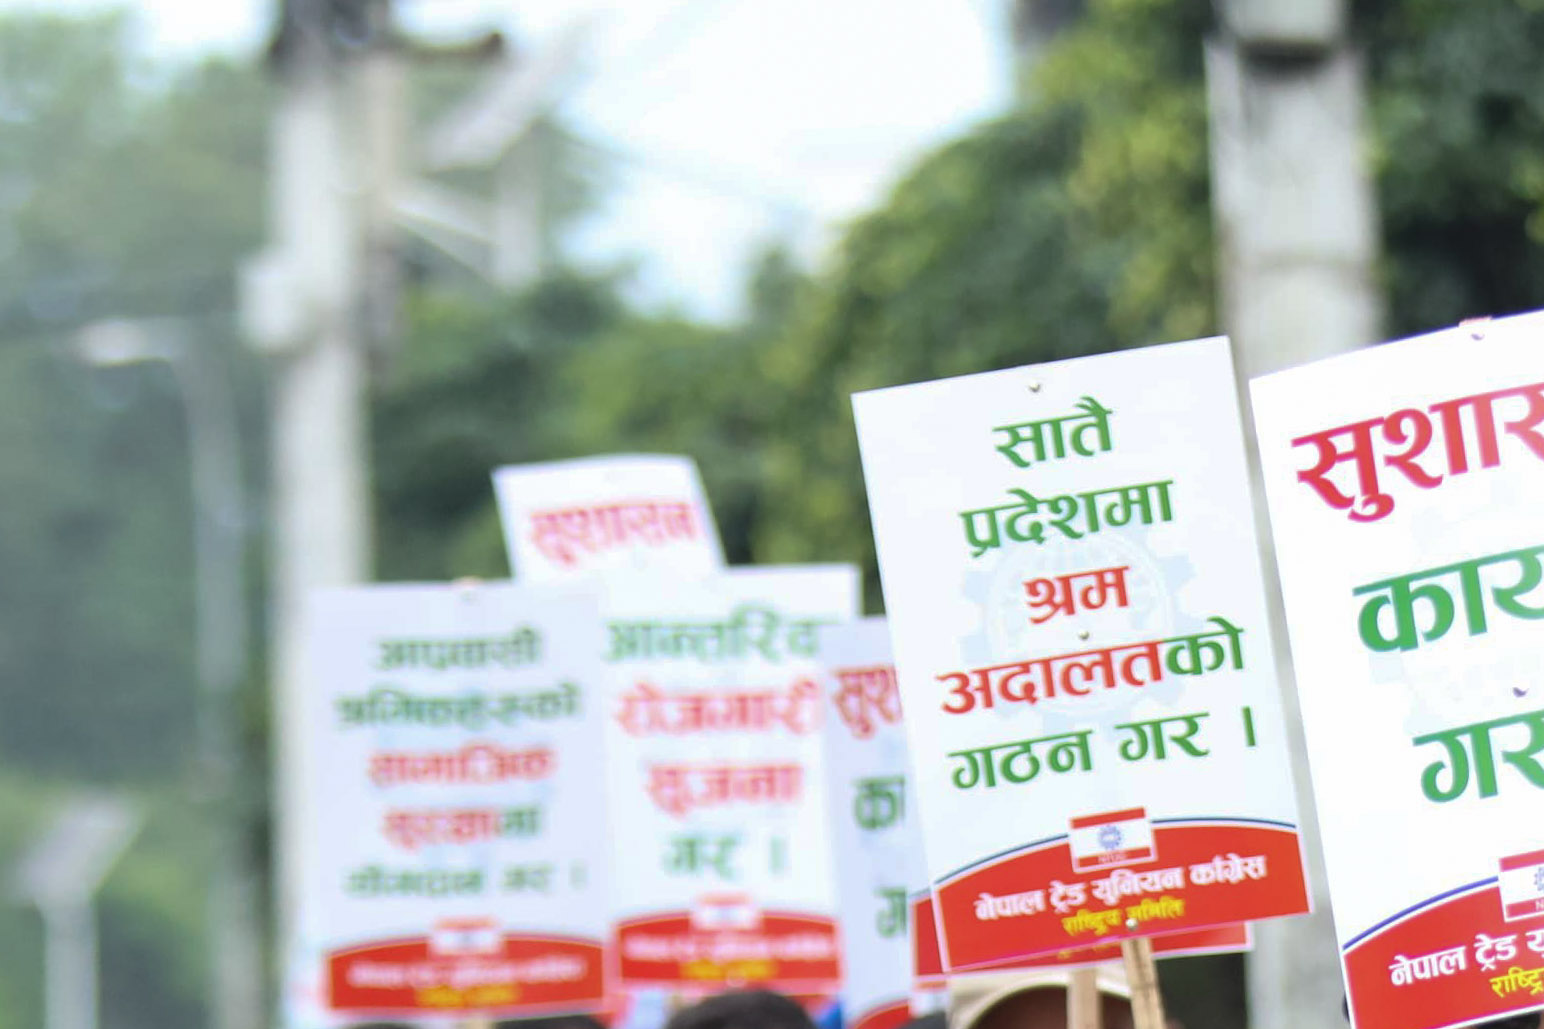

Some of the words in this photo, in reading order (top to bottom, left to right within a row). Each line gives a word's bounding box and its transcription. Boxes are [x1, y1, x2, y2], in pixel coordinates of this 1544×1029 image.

[992, 395, 1113, 468] सातै
[959, 479, 1174, 558] प्रदेशमा
[1023, 565, 1130, 625] श्रम
[936, 616, 1244, 715] अदालतको
[947, 728, 1095, 790] गठन
[1114, 711, 1211, 763] गर
[975, 893, 1045, 921] नेपाल
[1049, 881, 1088, 914] ट्रेड
[1389, 945, 1467, 986] नेपाल
[1474, 935, 1518, 972] ट्रेड
